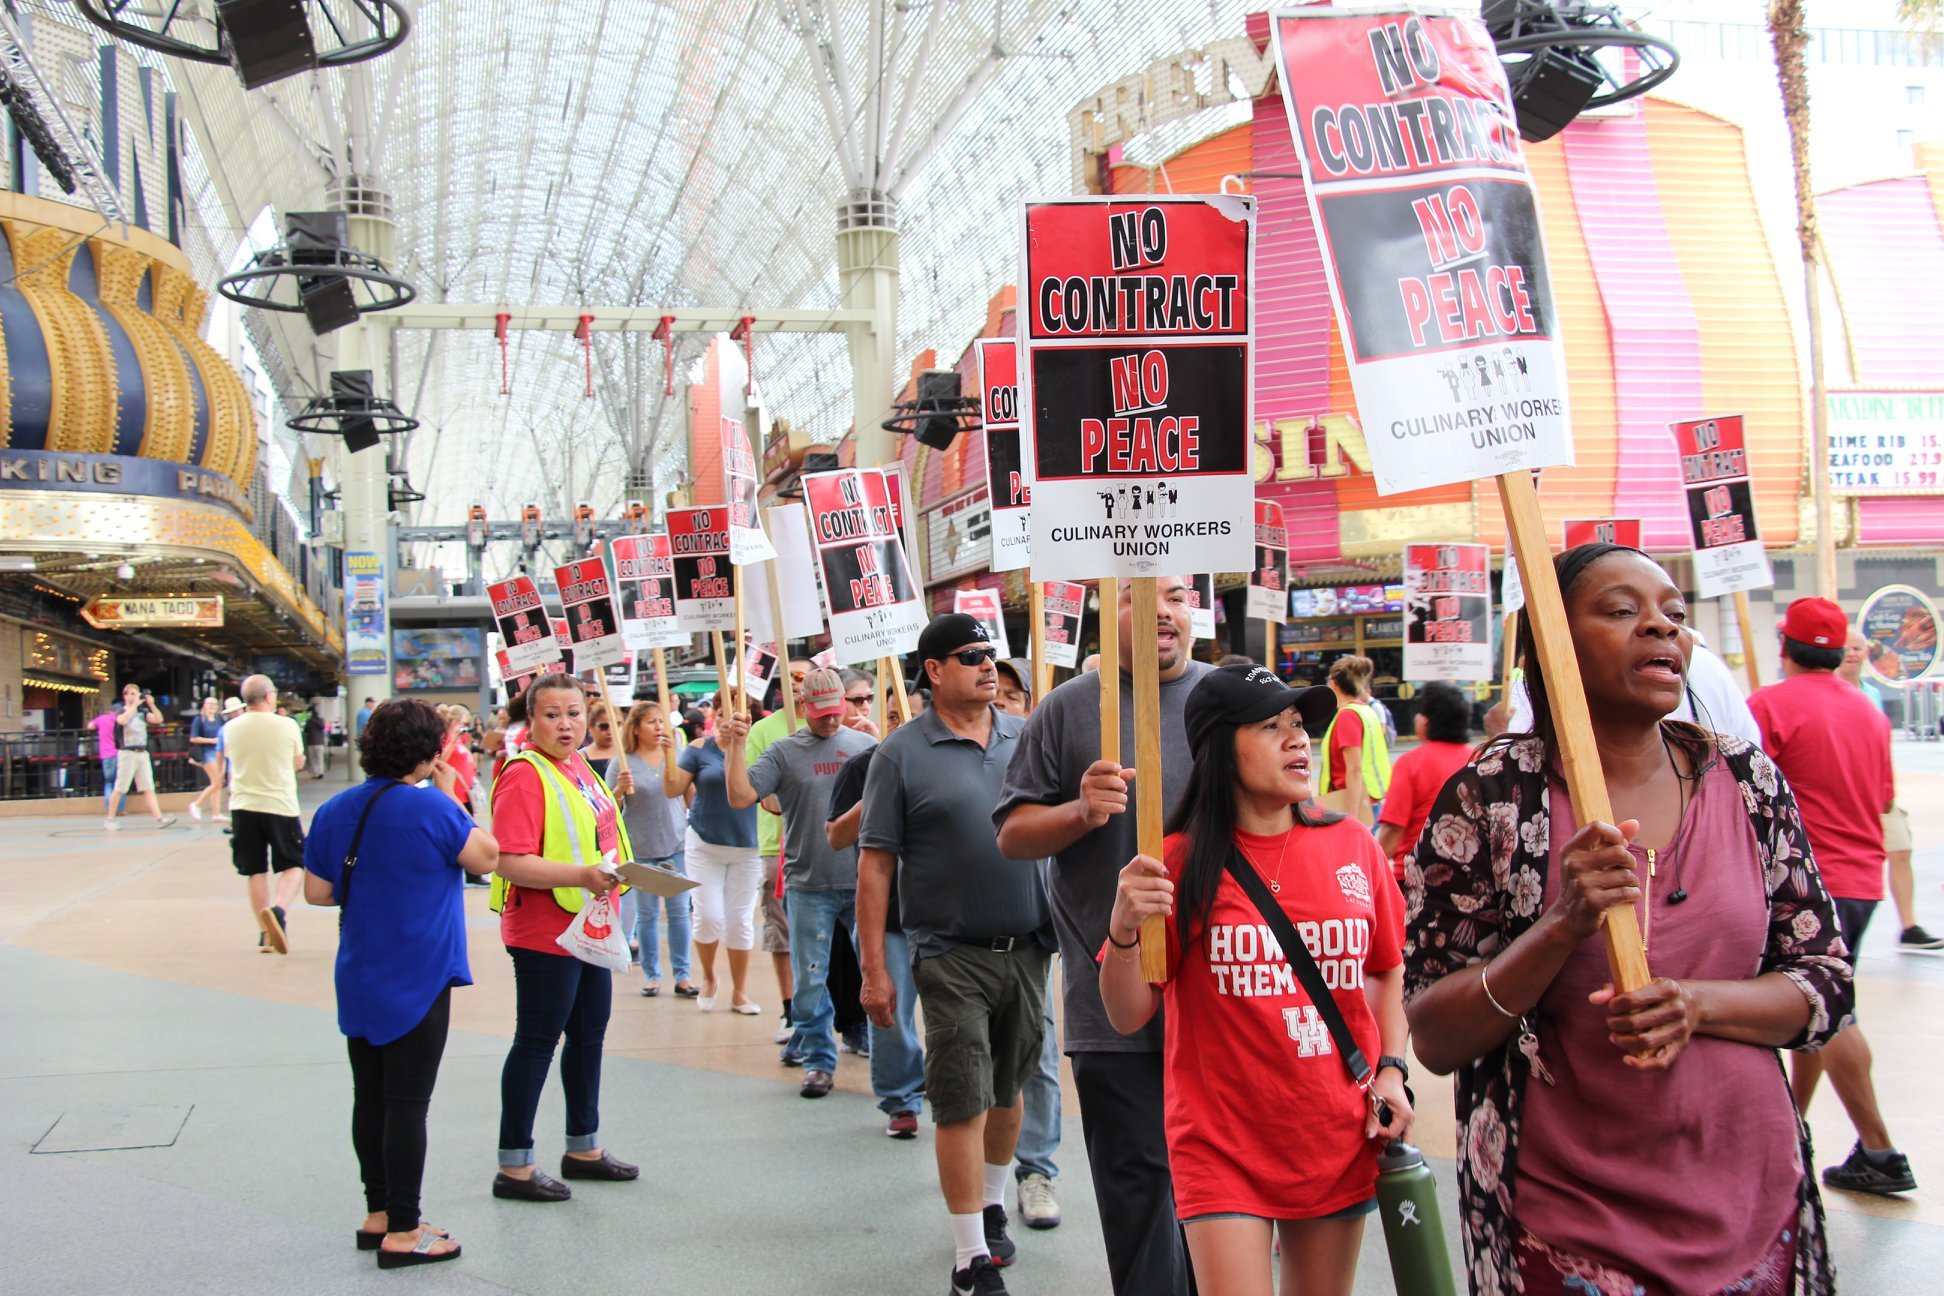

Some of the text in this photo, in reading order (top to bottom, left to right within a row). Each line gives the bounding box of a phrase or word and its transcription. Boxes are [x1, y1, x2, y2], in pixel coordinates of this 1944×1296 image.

[1368, 17, 1440, 97] NO
[1109, 206, 1168, 271] NO
[1410, 185, 1487, 268] NO
[1039, 274, 1238, 334] CONTRACT
[1398, 265, 1536, 347] PEACE
[1110, 349, 1169, 413] NO
[1390, 407, 1495, 440] CULINARY
[1693, 421, 1720, 452] NO
[1081, 415, 1200, 474] PEACE
[1471, 424, 1536, 450] UNION
[1877, 436, 1905, 447] RIB
[0, 457, 122, 483] KING
[840, 476, 863, 507] NO
[1703, 485, 1732, 518] NO
[691, 510, 711, 532] NO
[819, 506, 889, 540] CONTRCT
[1051, 520, 1231, 543] CULINARY WORKERS
[1595, 522, 1615, 544] NO
[1700, 514, 1746, 546] PEACE
[636, 538, 655, 557] NO
[856, 543, 878, 576] NO
[1113, 541, 1169, 557] UNION
[1437, 547, 1459, 569] NO
[697, 556, 716, 578] NO
[504, 581, 519, 597] NO
[641, 579, 661, 599] NO
[690, 577, 729, 598] PEACE
[161, 602, 195, 615] TACO
[634, 598, 672, 618] PEACE
[1435, 597, 1460, 619] NO
[844, 629, 885, 645] CULINARY
[1425, 620, 1472, 641] PEACE
[1210, 924, 1284, 962] HOW
[1211, 957, 1365, 997] THEM OO
[1282, 1005, 1332, 1058] UH
